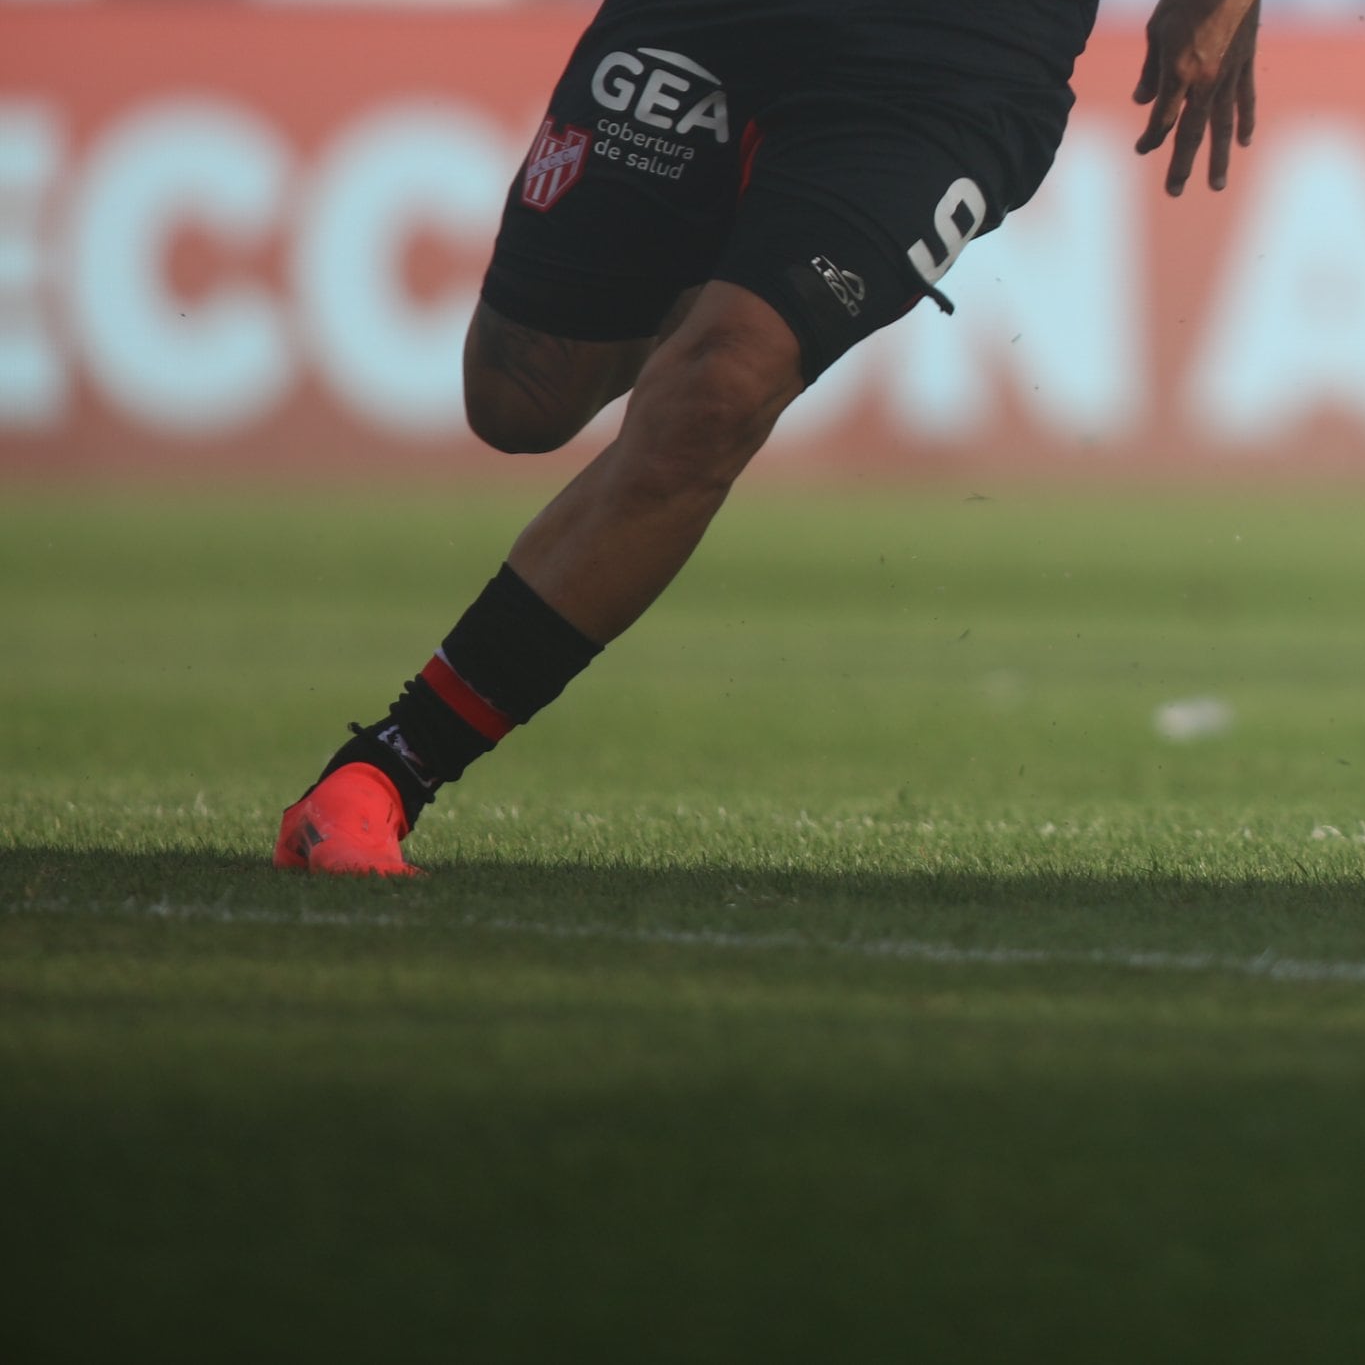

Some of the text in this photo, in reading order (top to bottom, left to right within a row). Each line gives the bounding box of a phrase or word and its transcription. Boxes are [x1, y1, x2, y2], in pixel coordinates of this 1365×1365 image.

[591, 51, 729, 144] GEA
[594, 139, 685, 180] de salud
[597, 118, 695, 160] cobertura
[907, 177, 987, 287] 9
